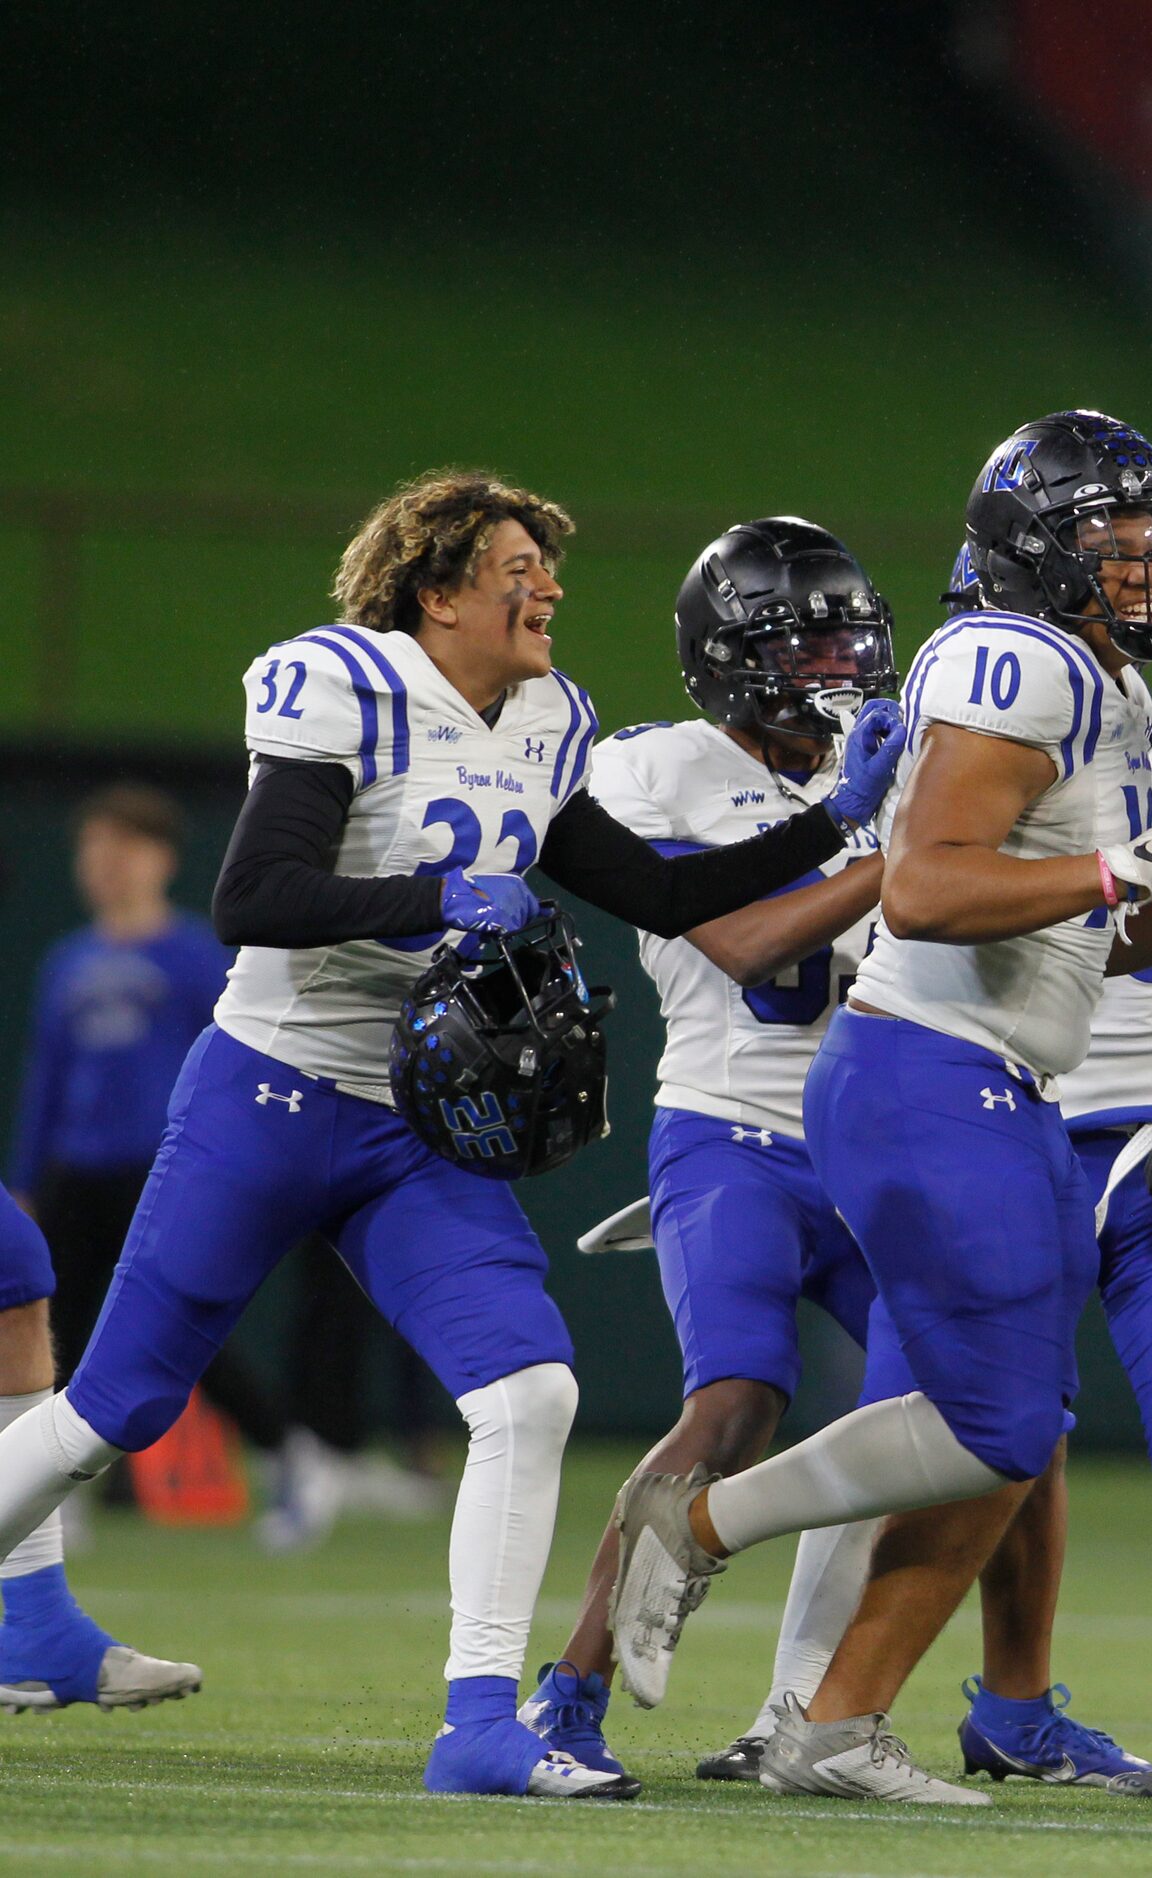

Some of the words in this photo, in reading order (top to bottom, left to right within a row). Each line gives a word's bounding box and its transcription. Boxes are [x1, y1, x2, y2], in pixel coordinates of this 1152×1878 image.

[256, 659, 308, 720] 32
[966, 645, 1022, 711] 10
[456, 765, 492, 791] Byron
[495, 769, 525, 794] Nelson
[438, 1090, 519, 1159] 32
